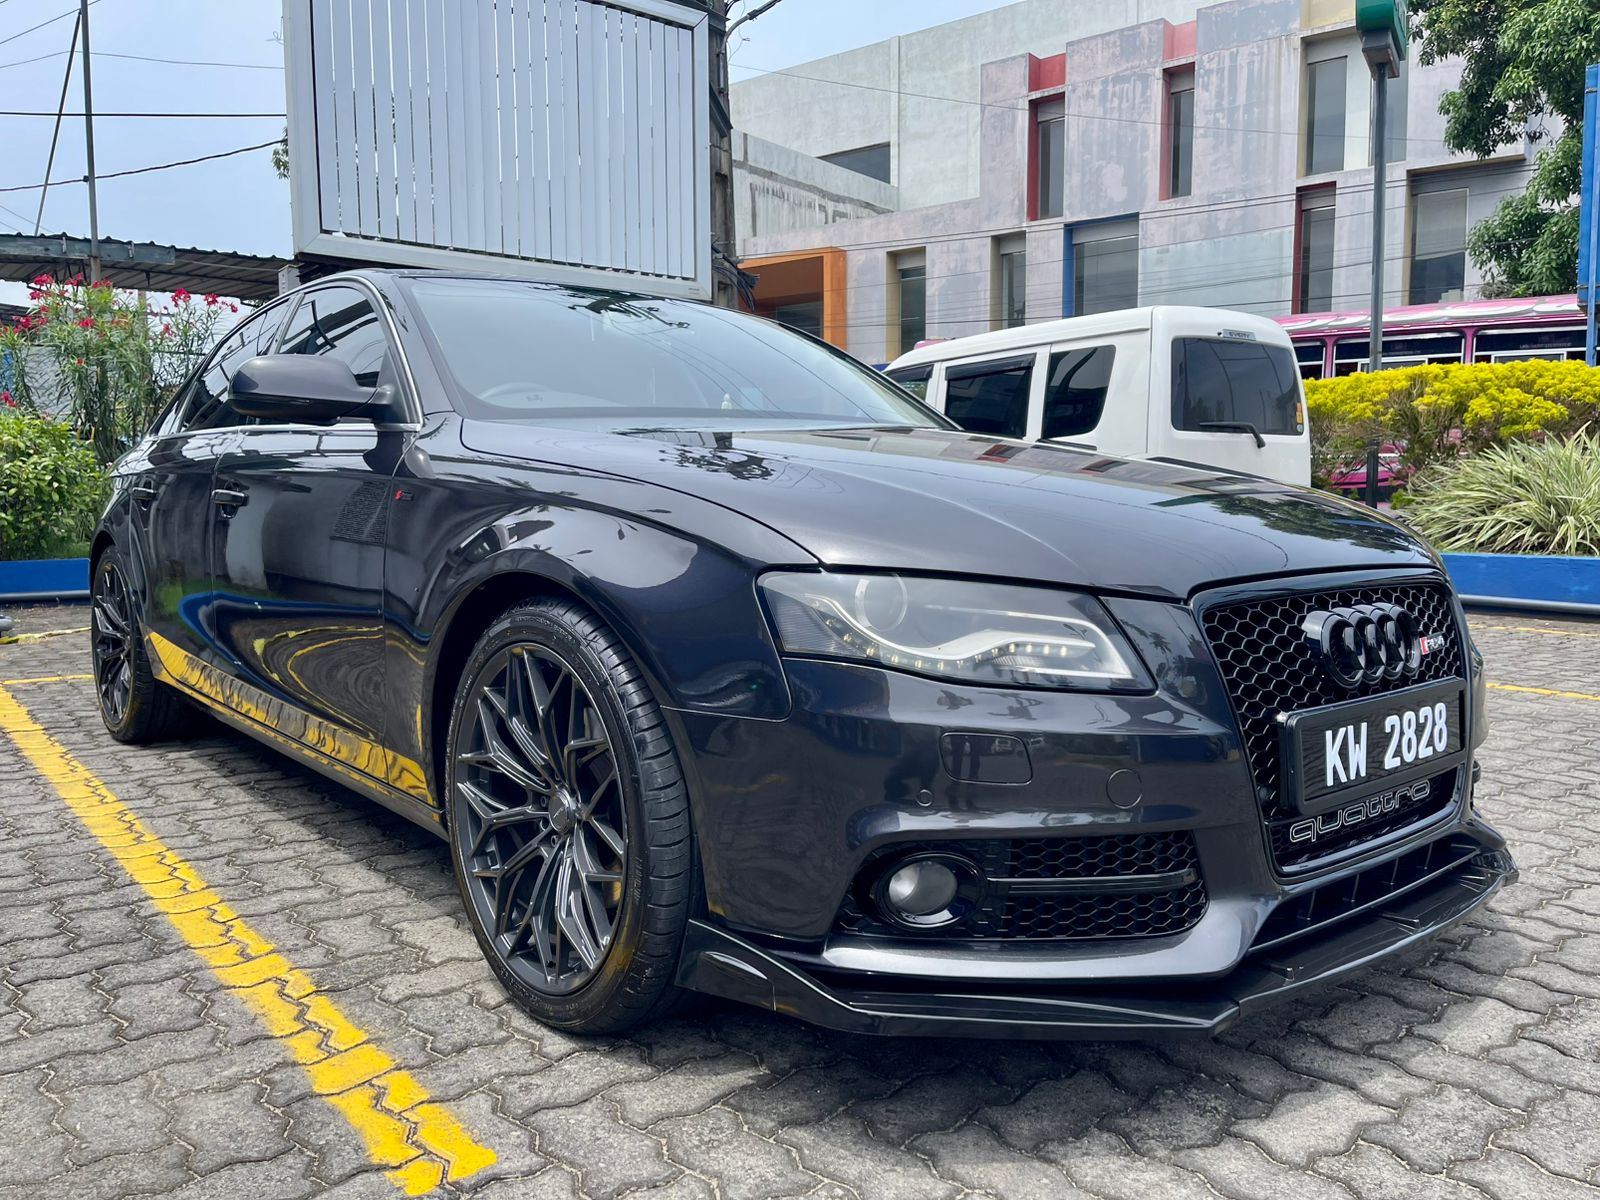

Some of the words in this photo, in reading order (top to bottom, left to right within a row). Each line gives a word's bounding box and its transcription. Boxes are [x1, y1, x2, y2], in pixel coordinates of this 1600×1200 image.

[1326, 722, 1367, 786] KW
[1384, 702, 1448, 770] 2828
[1290, 780, 1430, 842] quattro
